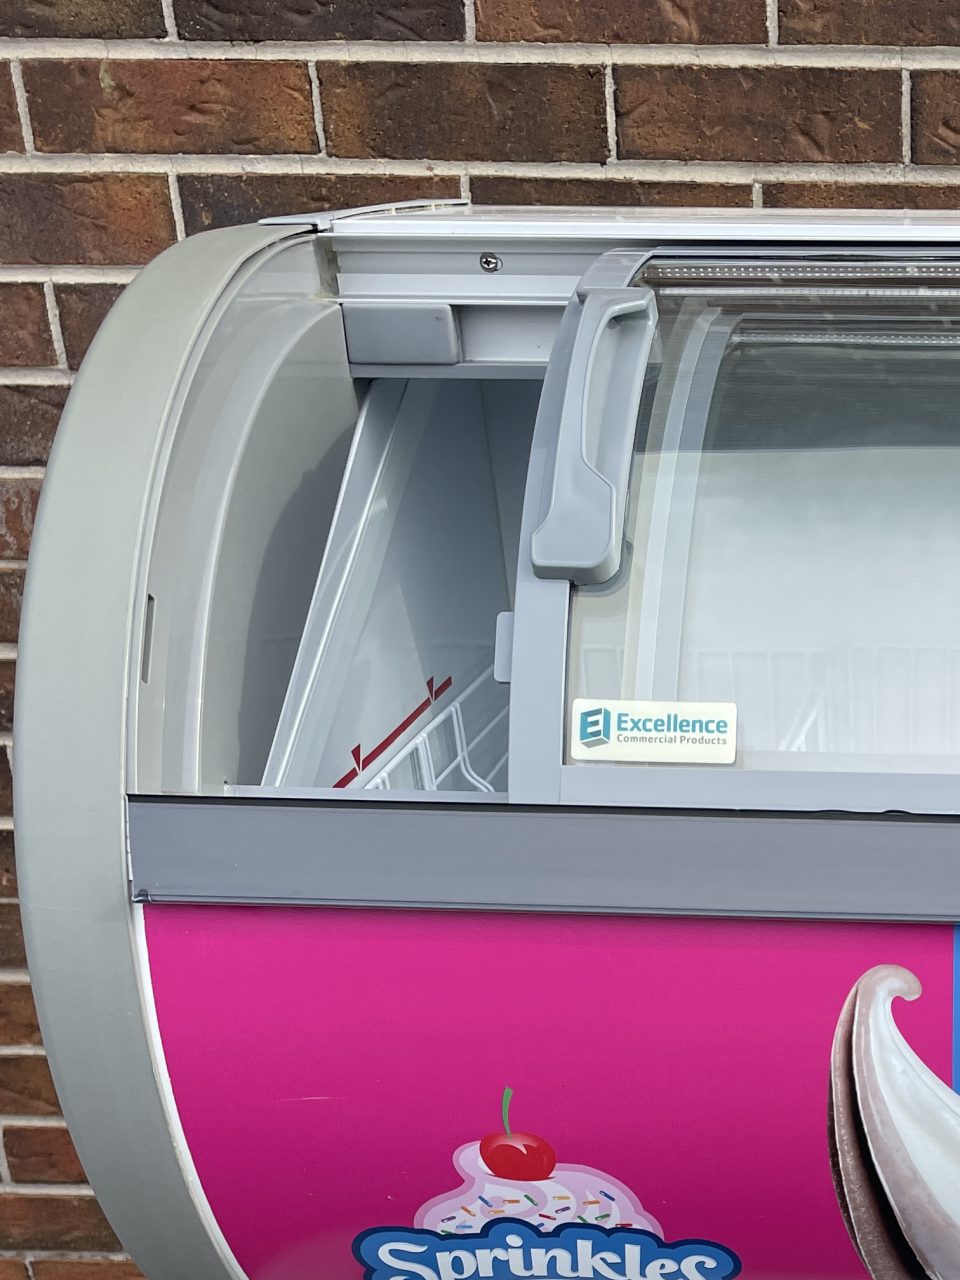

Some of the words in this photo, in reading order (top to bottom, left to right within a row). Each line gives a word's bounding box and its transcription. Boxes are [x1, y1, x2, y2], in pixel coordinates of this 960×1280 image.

[616, 712, 728, 734] Excellence
[616, 733, 677, 744] Commercial
[679, 735, 727, 745] Products
